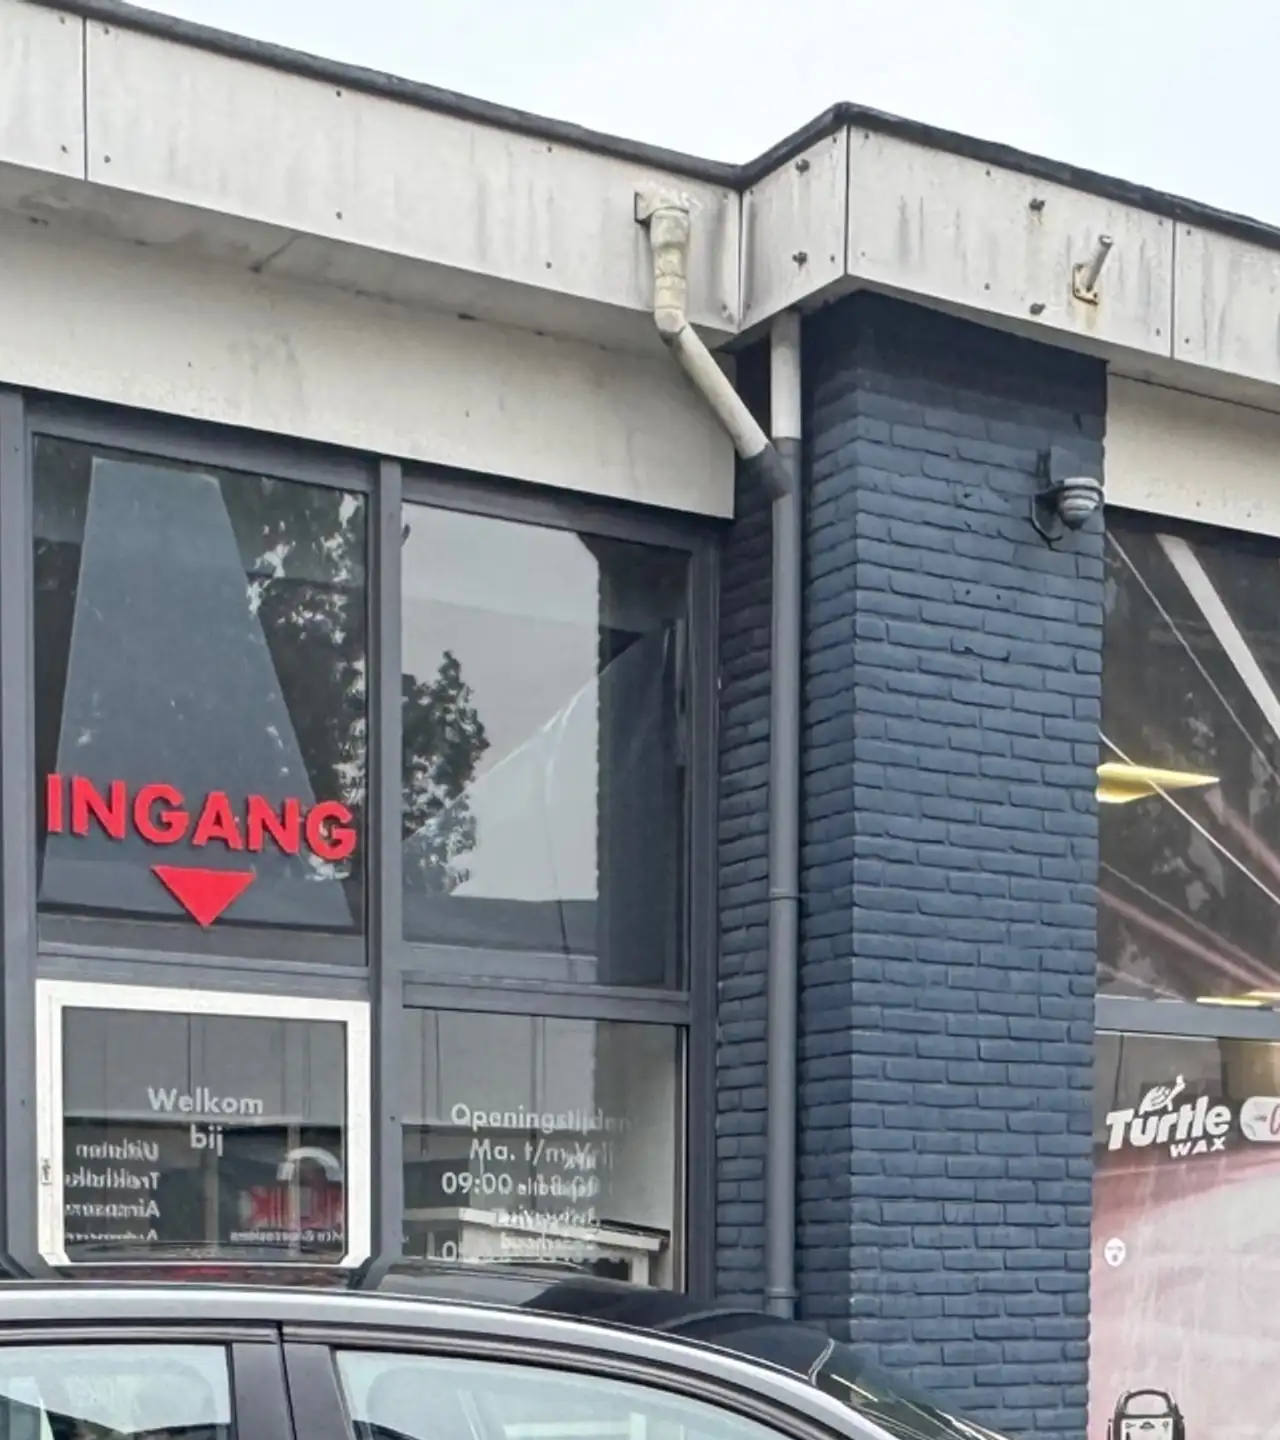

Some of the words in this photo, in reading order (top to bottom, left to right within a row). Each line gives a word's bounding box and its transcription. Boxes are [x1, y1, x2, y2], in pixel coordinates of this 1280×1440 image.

[46, 773, 357, 860] INGANG
[147, 1085, 264, 1115] Welkom
[1106, 1096, 1232, 1151] Turtle
[190, 1124, 224, 1157] bij
[470, 1138, 516, 1161] Ma.
[1170, 1136, 1226, 1158] WAX
[441, 1171, 513, 1195] 09:00
